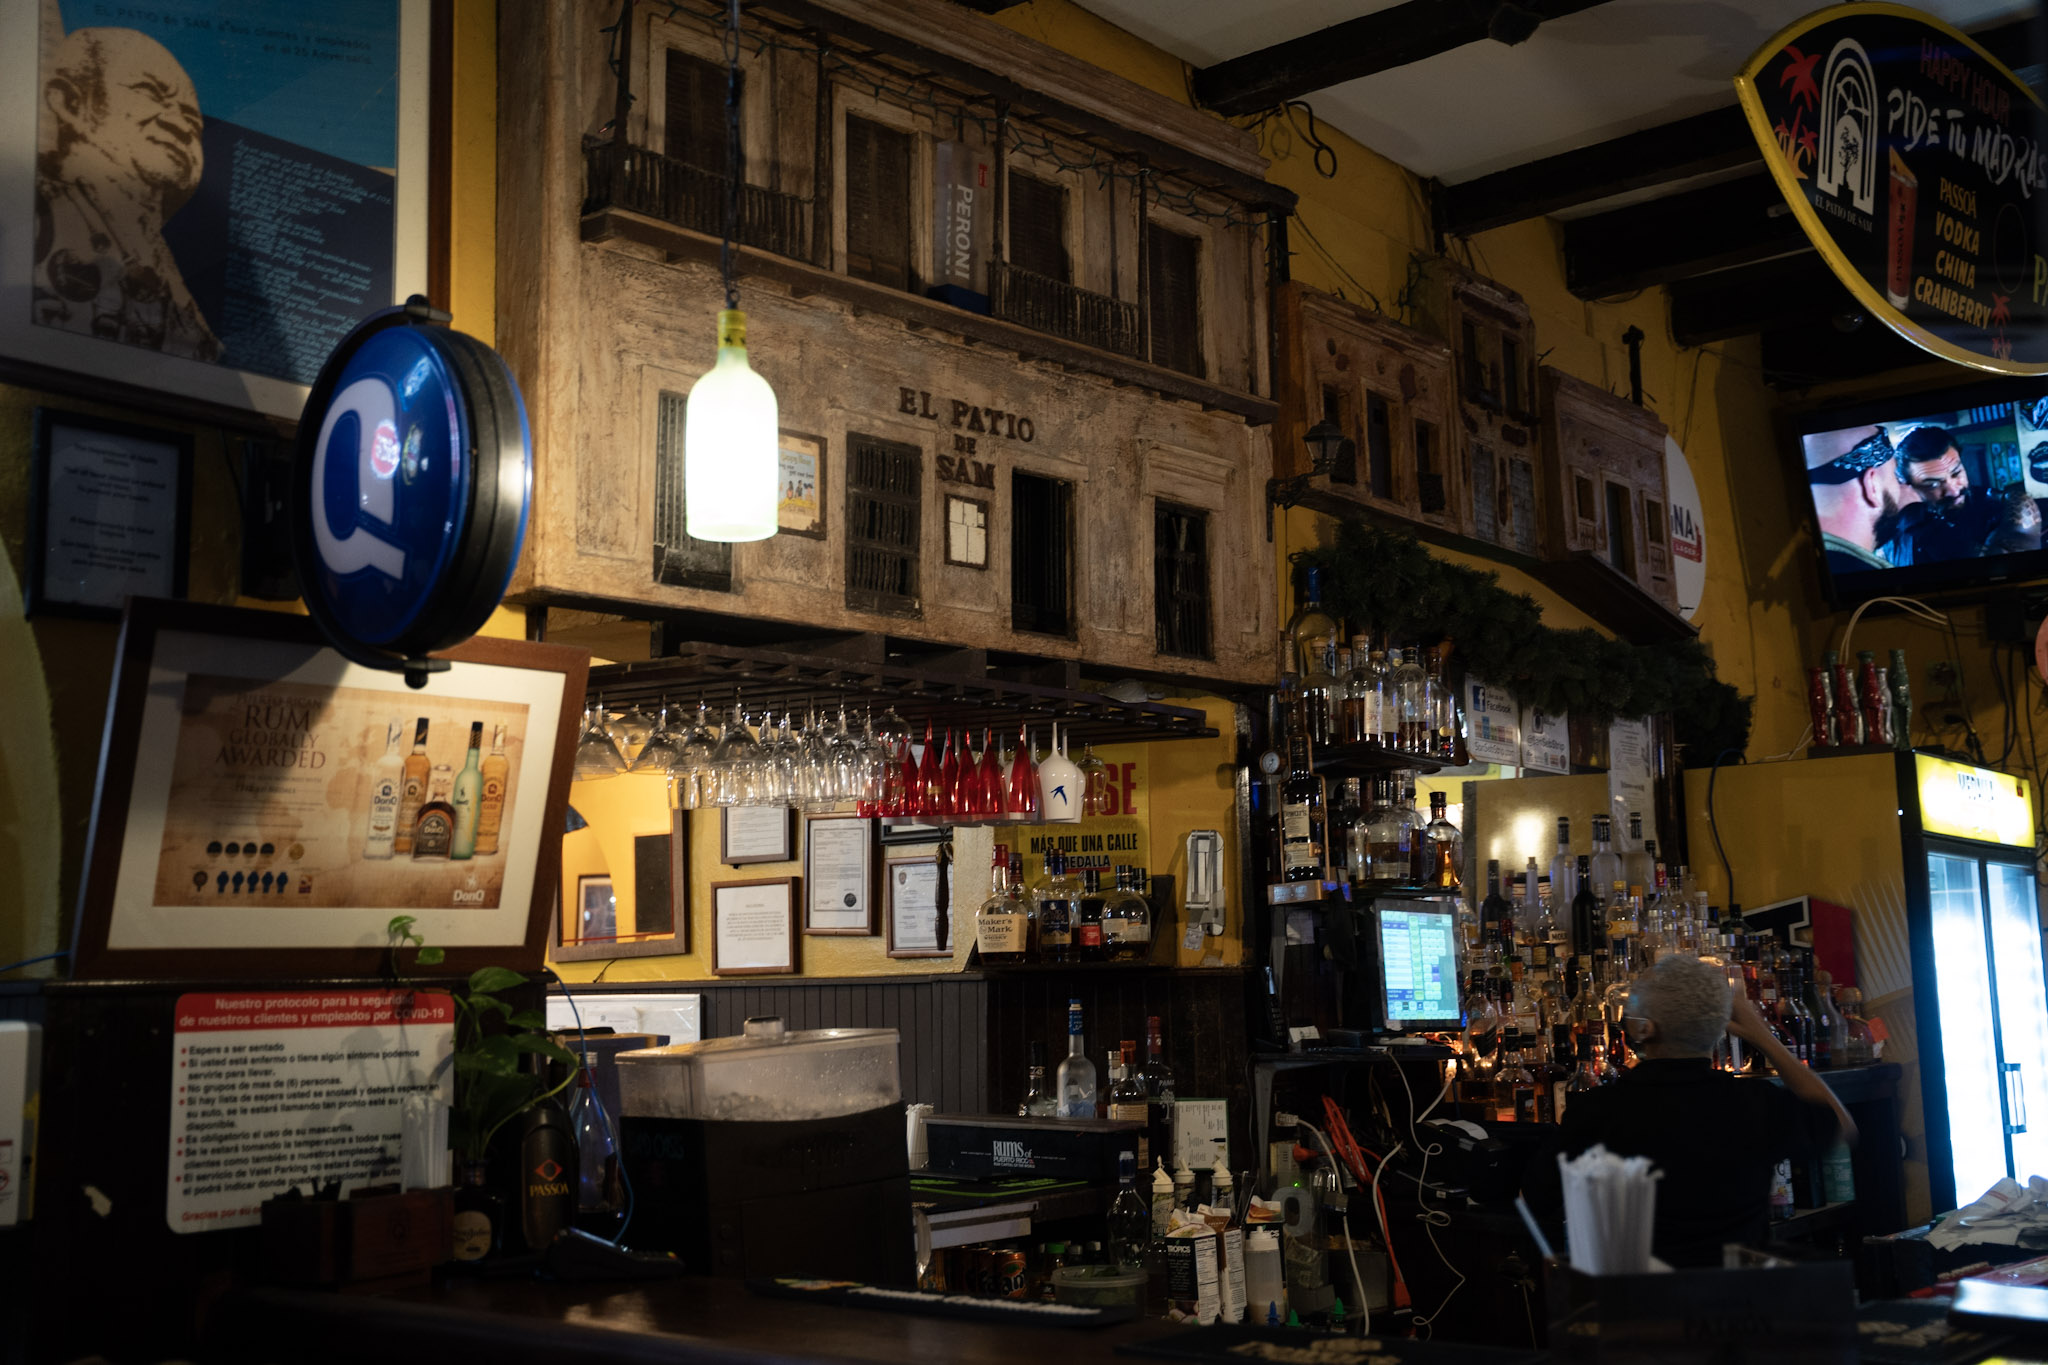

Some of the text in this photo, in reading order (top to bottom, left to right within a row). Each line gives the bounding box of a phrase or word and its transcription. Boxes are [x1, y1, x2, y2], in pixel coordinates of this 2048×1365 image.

[1921, 37, 2010, 127] HAPPY HOUR
[1887, 87, 1941, 153] PIDE
[1971, 122, 2048, 199] MADRAS
[1815, 194, 1873, 233] EL PATIO DE SAM
[954, 184, 974, 280] PERONI
[1935, 210, 1980, 256] VODKA
[1935, 249, 1976, 290] CHINA
[1914, 276, 1992, 330] CRANBERRY
[898, 386, 1035, 443] EL PATIO
[954, 434, 976, 455] DE
[936, 454, 996, 490] SAM
[1487, 701, 1512, 713] Facebook
[245, 704, 310, 732] RUM
[230, 728, 320, 749] GLOBALLY
[216, 746, 326, 769] AWARDED
[1031, 833, 1138, 854] MÁS QUE UNA CALLE
[453, 889, 485, 902] DonQ
[978, 918, 1013, 926] Maker's
[215, 998, 262, 1010] Nuestro
[265, 996, 319, 1011] protocolo
[322, 997, 347, 1010] para
[349, 995, 360, 1006] la
[179, 1016, 195, 1027] de
[198, 1014, 251, 1026] nuestros
[253, 1011, 298, 1024] clientes
[311, 1010, 371, 1025] empleados
[373, 1010, 392, 1022] por
[394, 1007, 445, 1020] COVID-19
[201, 1057, 227, 1068] usted
[251, 1054, 287, 1066] enfermo
[297, 1053, 319, 1063] tiene
[321, 1051, 344, 1063] algún
[382, 1049, 420, 1061] podemos
[225, 1070, 247, 1081] para
[204, 1083, 238, 1095] grupos
[286, 1089, 311, 1100] usted
[280, 1101, 320, 1112] llamando
[294, 1137, 347, 1149] temperatura
[249, 1166, 272, 1176] Valet
[274, 1163, 309, 1176] Parking
